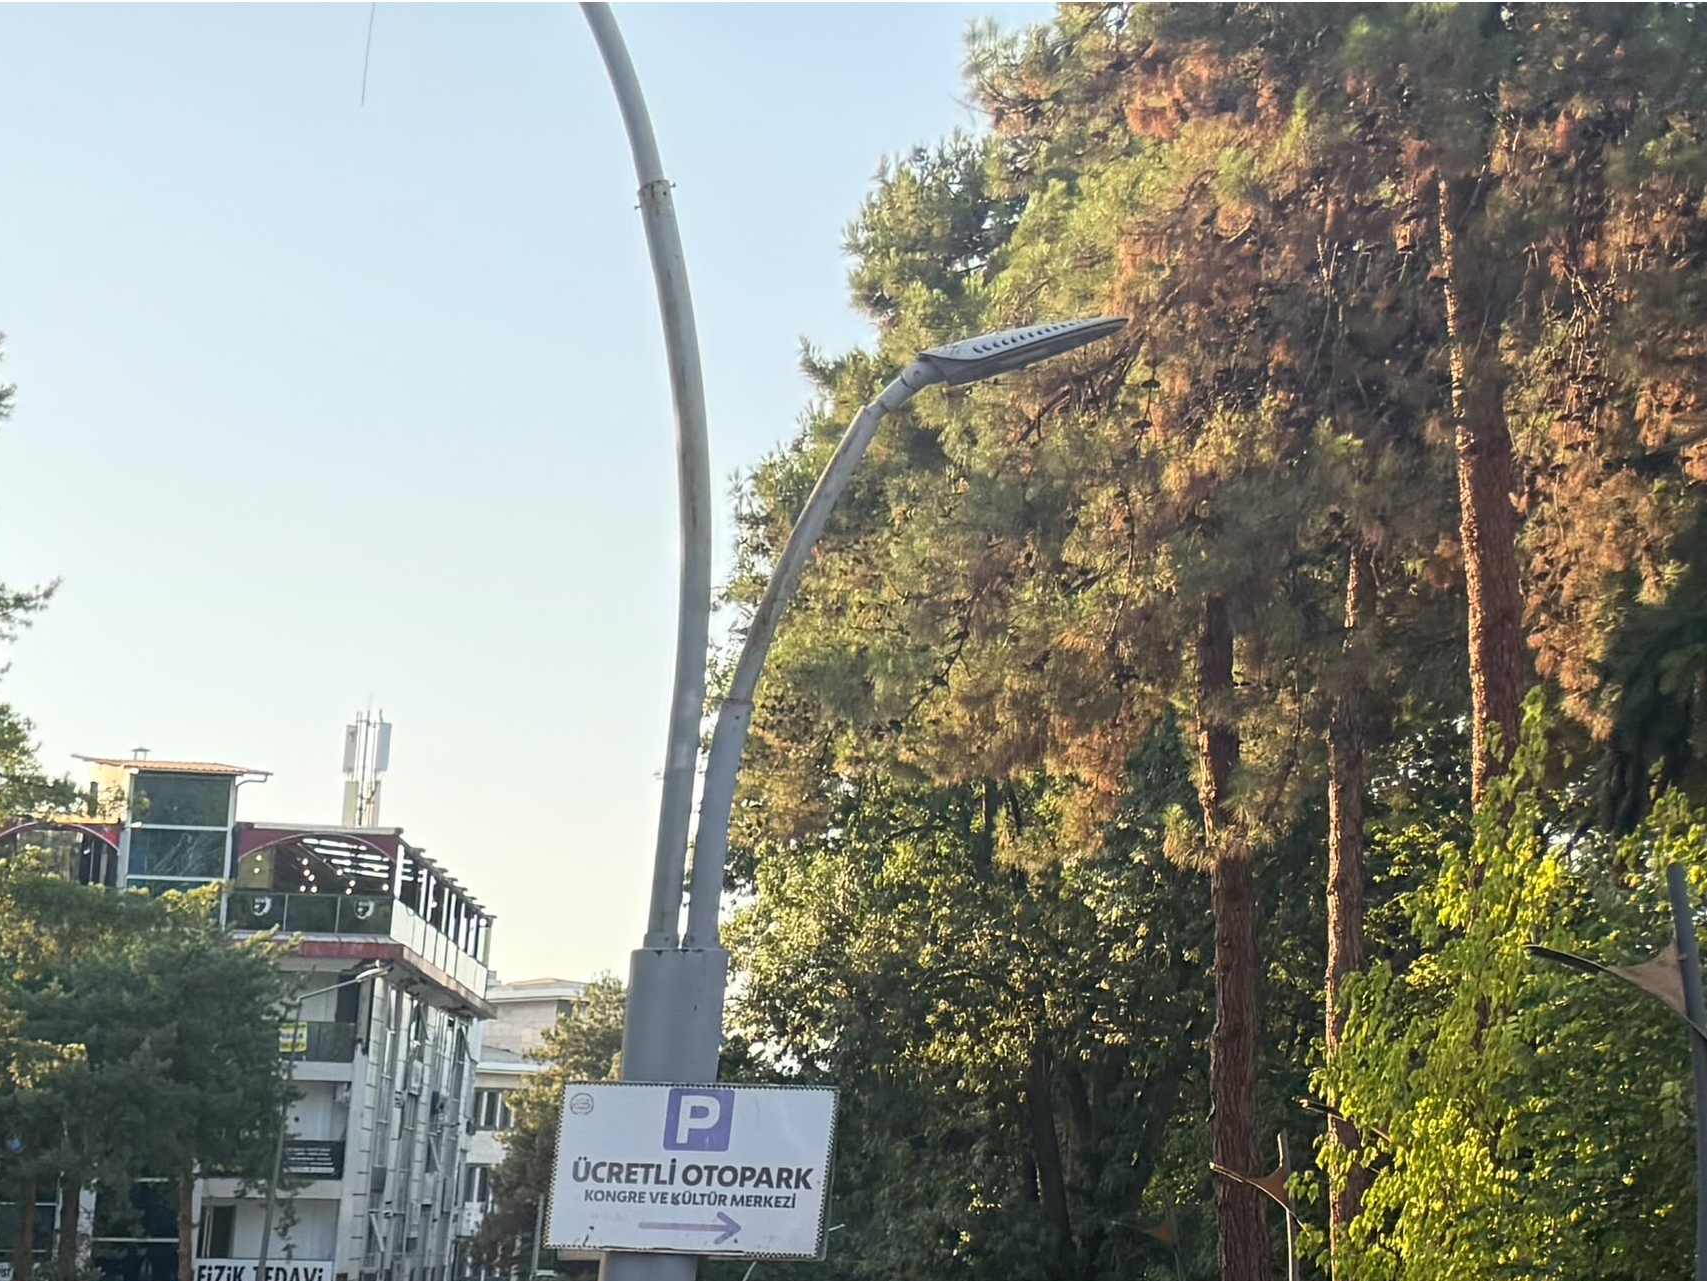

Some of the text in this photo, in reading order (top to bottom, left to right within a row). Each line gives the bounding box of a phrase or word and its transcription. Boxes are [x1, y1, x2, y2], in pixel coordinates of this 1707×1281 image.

[676, 1095, 721, 1145] P
[572, 1156, 814, 1190] ÜCRETLİ OTOPARK
[584, 1189, 796, 1209] KONGRE VE KÜLTÜR MERKEZİ
